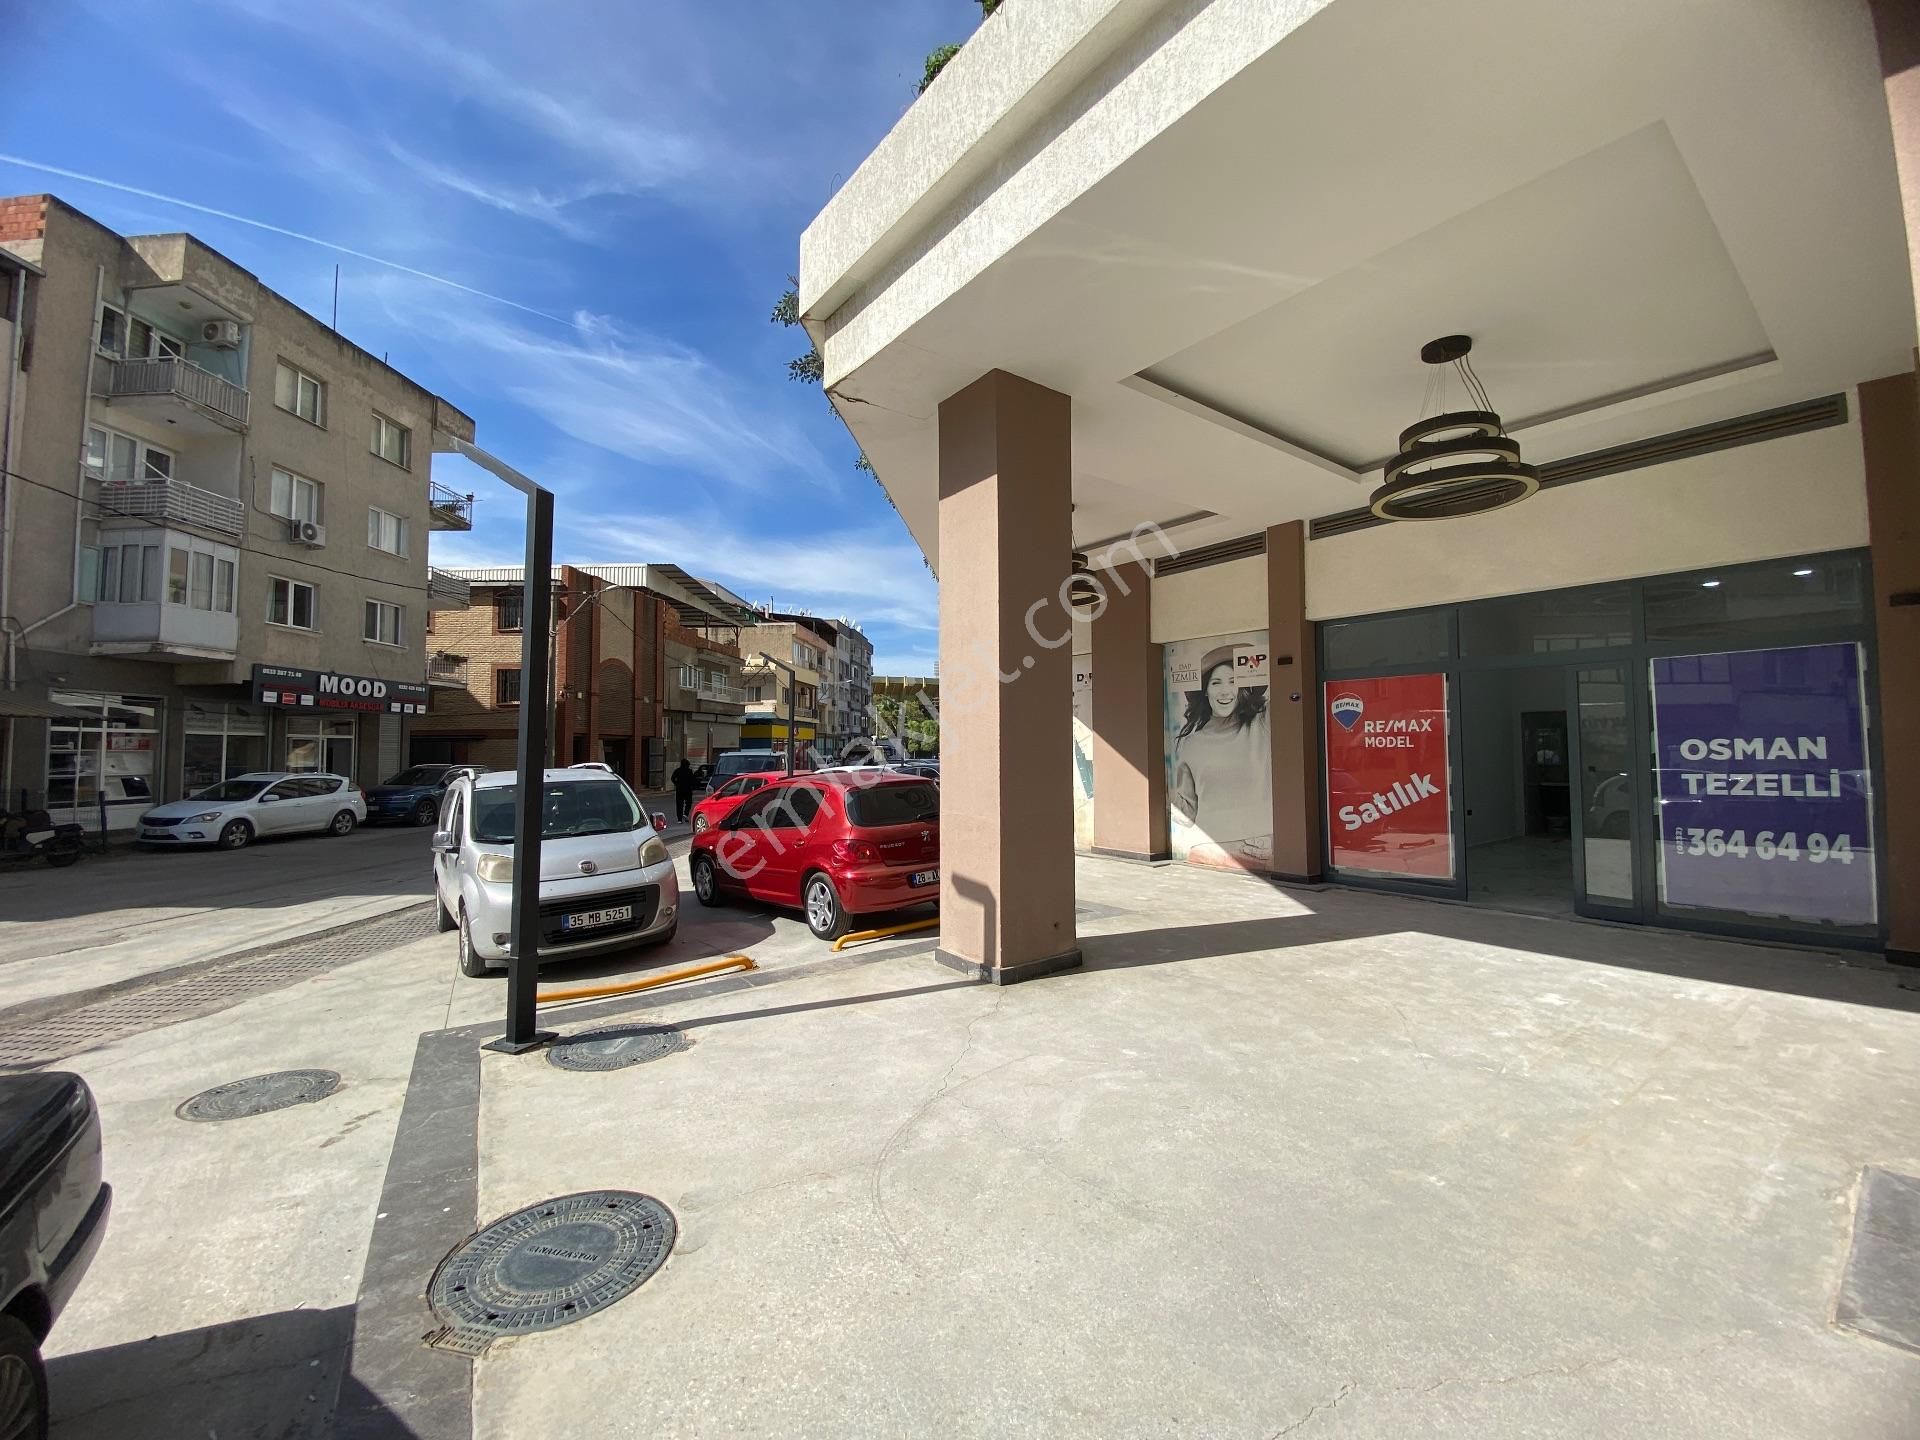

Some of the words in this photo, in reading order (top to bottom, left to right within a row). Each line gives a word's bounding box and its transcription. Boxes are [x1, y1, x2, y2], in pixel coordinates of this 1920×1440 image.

[319, 674, 387, 698] MOOD
[1335, 701, 1360, 710] RE/MAX
[1364, 718, 1432, 733] RE/MAX
[1364, 736, 1415, 748] MODEL
[1679, 736, 1828, 761] OSMAN
[1681, 768, 1841, 798] TEZELLİ
[1338, 772, 1441, 831] Satılık
[1687, 828, 1749, 859] 364
[1755, 830, 1801, 862] 64
[1807, 832, 1855, 865] 94
[570, 915, 584, 927] 35
[588, 912, 601, 924] MB
[605, 907, 630, 921] 5251
